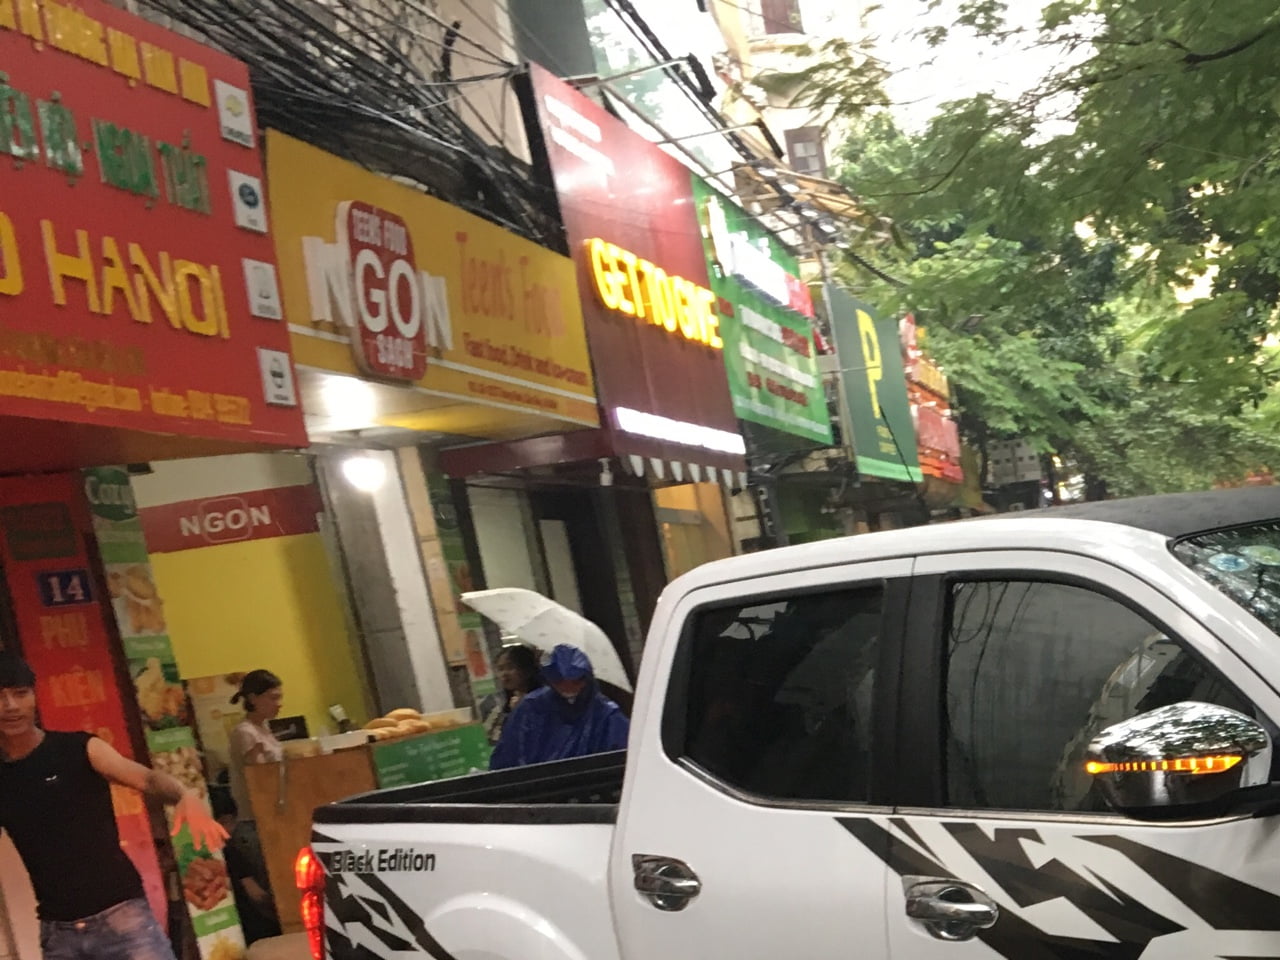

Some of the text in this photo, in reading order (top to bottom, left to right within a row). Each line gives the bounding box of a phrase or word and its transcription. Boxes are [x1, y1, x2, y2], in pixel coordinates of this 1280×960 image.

[41, 220, 230, 339] HANOI
[302, 234, 454, 350] NGON
[180, 505, 271, 537] NGON
[48, 575, 85, 603] 14
[331, 847, 436, 873] Black Edition
